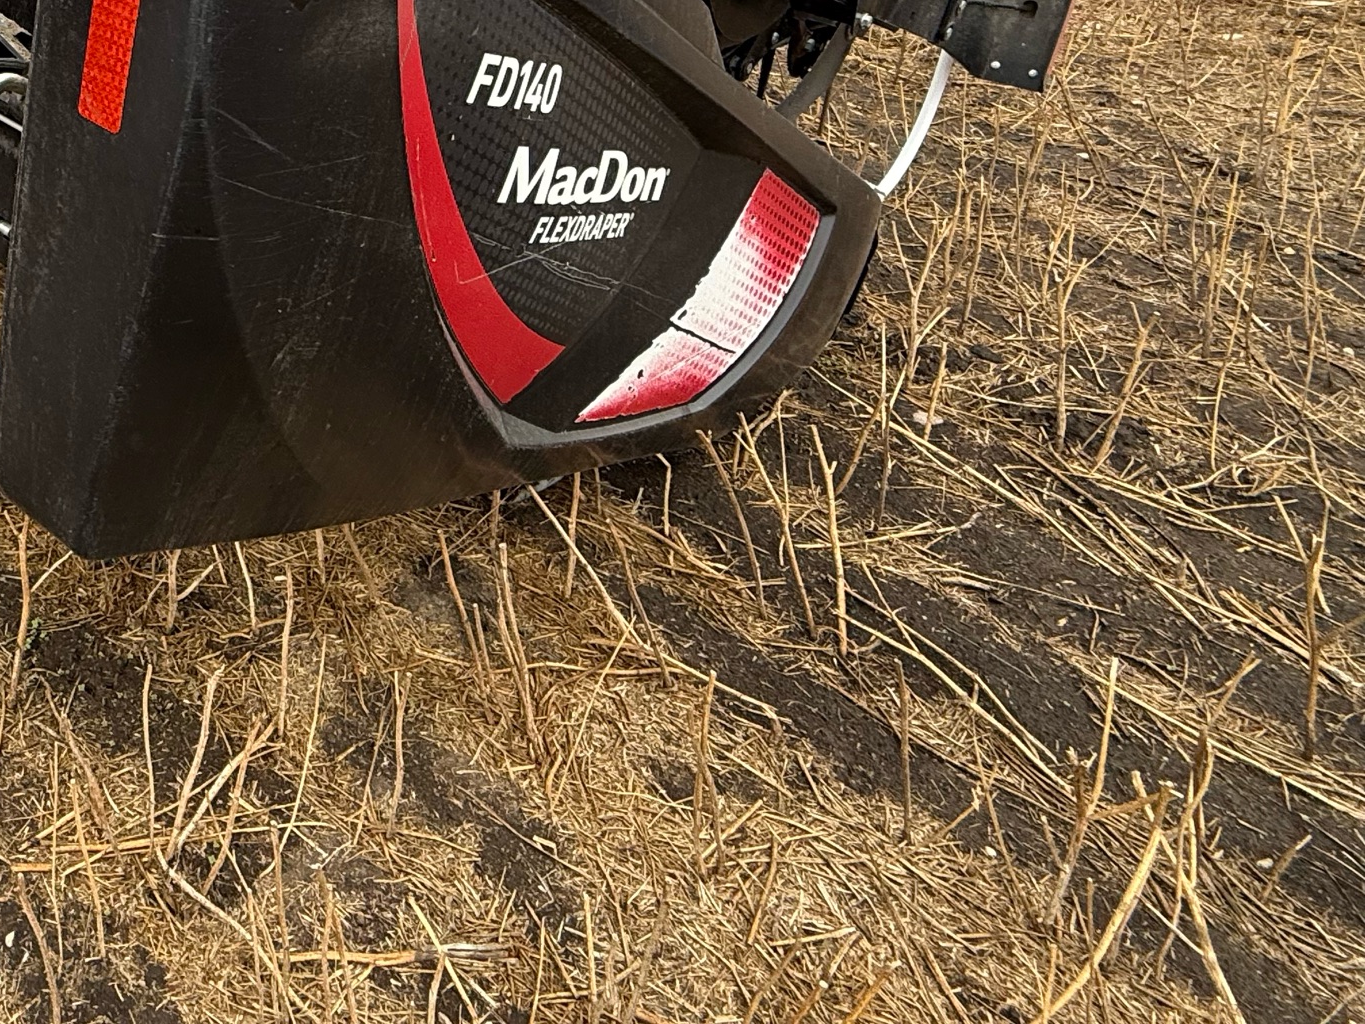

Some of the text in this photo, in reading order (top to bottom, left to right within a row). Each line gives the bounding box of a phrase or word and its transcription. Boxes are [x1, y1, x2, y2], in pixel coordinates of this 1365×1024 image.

[466, 53, 563, 114] FD140
[497, 146, 668, 206] MacDon
[529, 213, 631, 244] FLEXDRAPER
